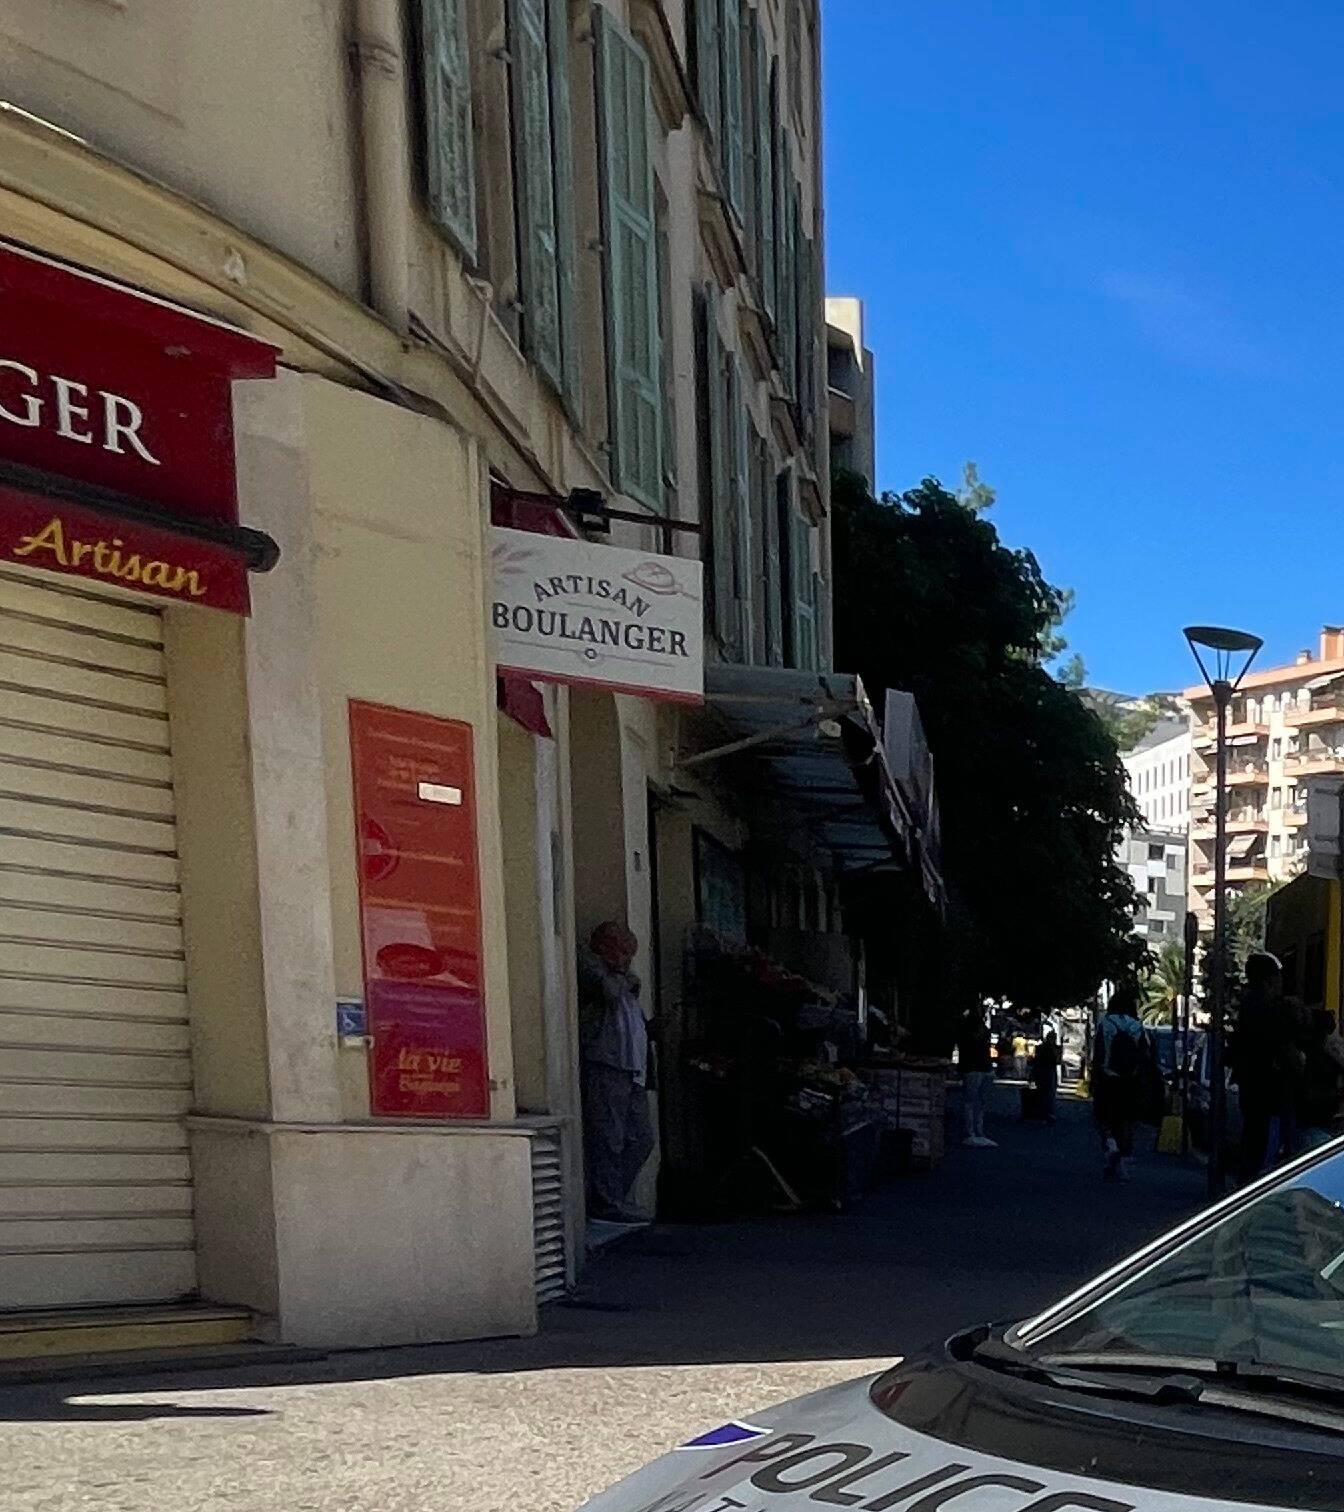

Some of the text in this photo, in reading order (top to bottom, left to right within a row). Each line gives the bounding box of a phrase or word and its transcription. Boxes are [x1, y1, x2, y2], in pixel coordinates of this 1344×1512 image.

[0, 359, 161, 466] GER
[13, 517, 207, 595] Artisan
[533, 574, 651, 618] ARTISAN
[492, 602, 690, 658] BOULANGER
